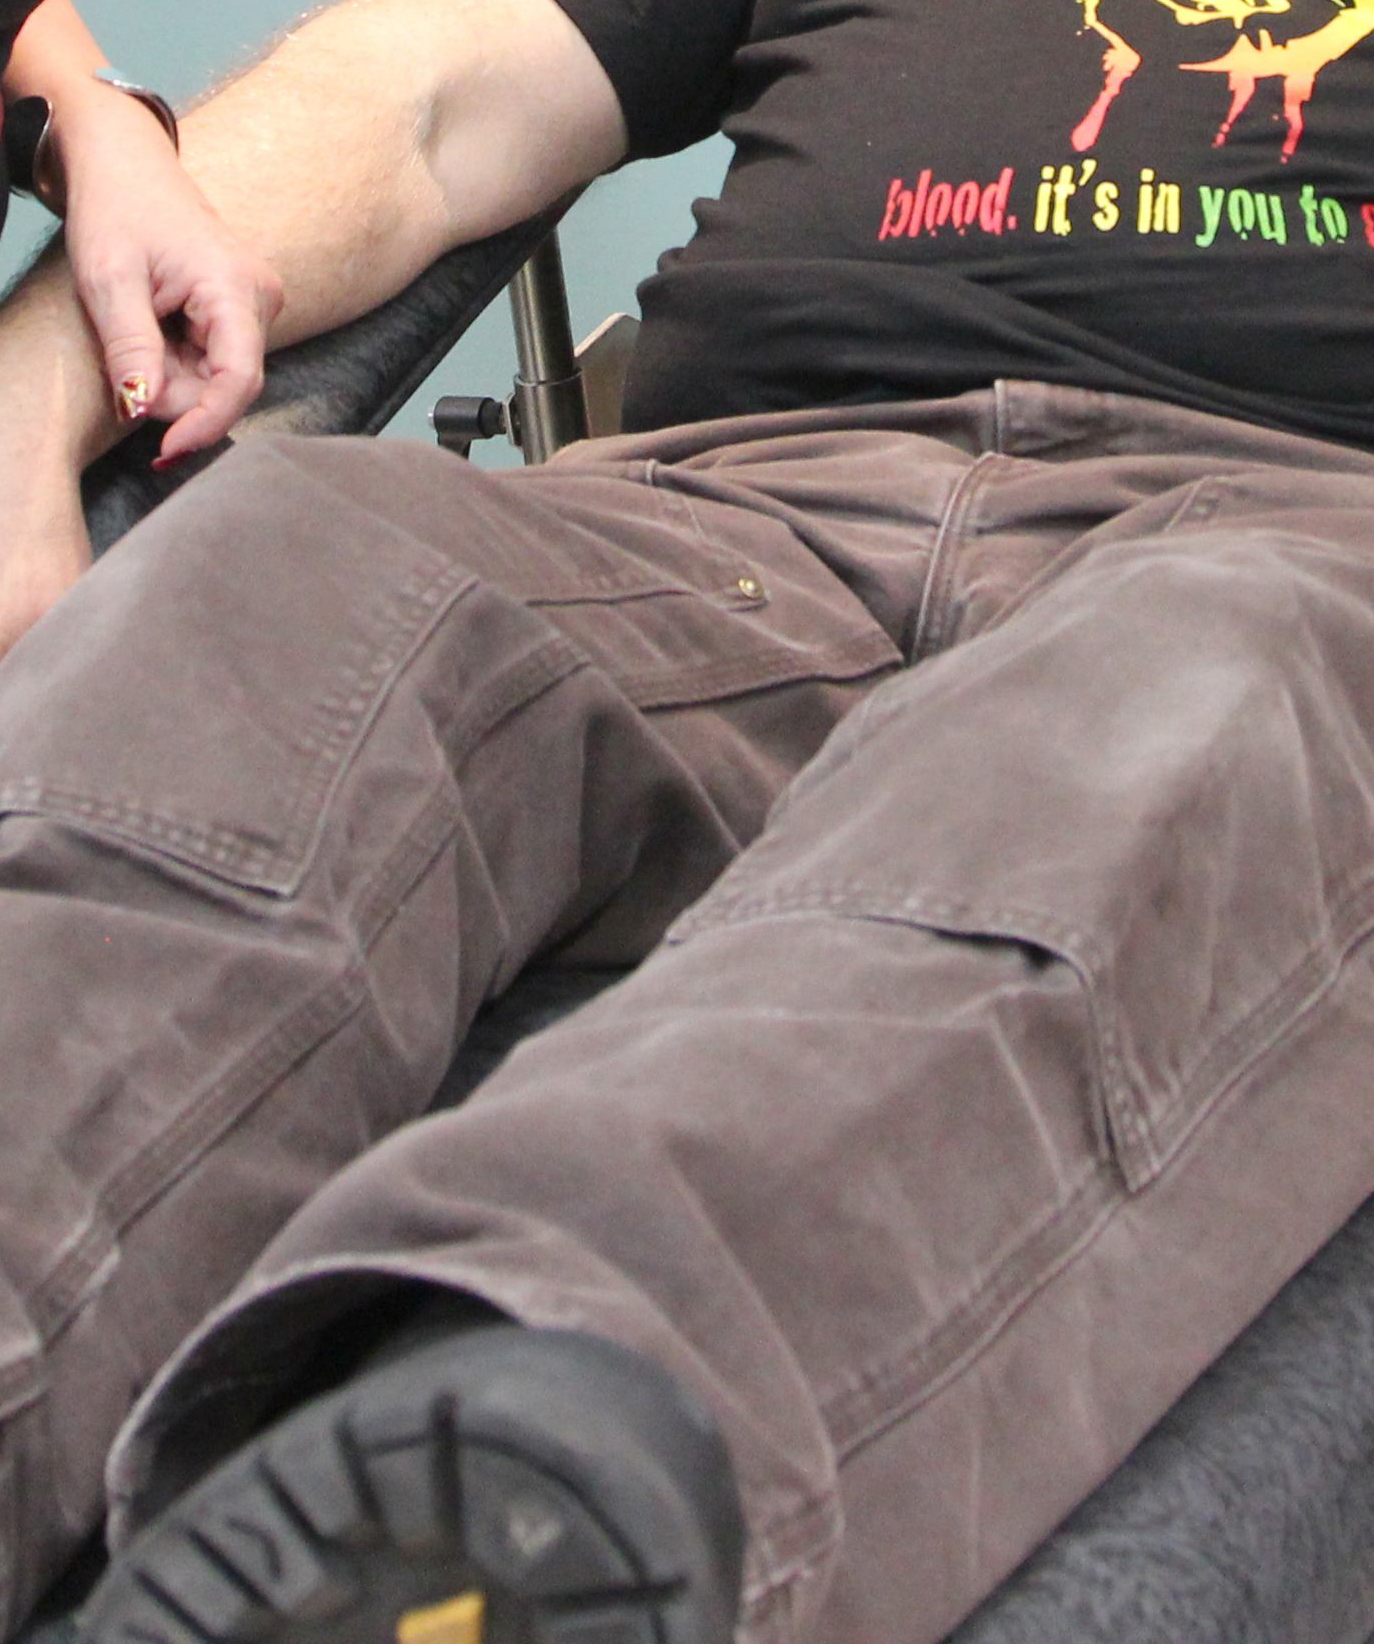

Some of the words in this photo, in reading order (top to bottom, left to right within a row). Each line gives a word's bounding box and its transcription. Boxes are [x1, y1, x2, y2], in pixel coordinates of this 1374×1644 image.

[879, 168, 1017, 240] blood.
[1033, 158, 1119, 235] it's
[1136, 168, 1180, 234] in
[1195, 184, 1288, 248] you
[1299, 184, 1349, 246] to
